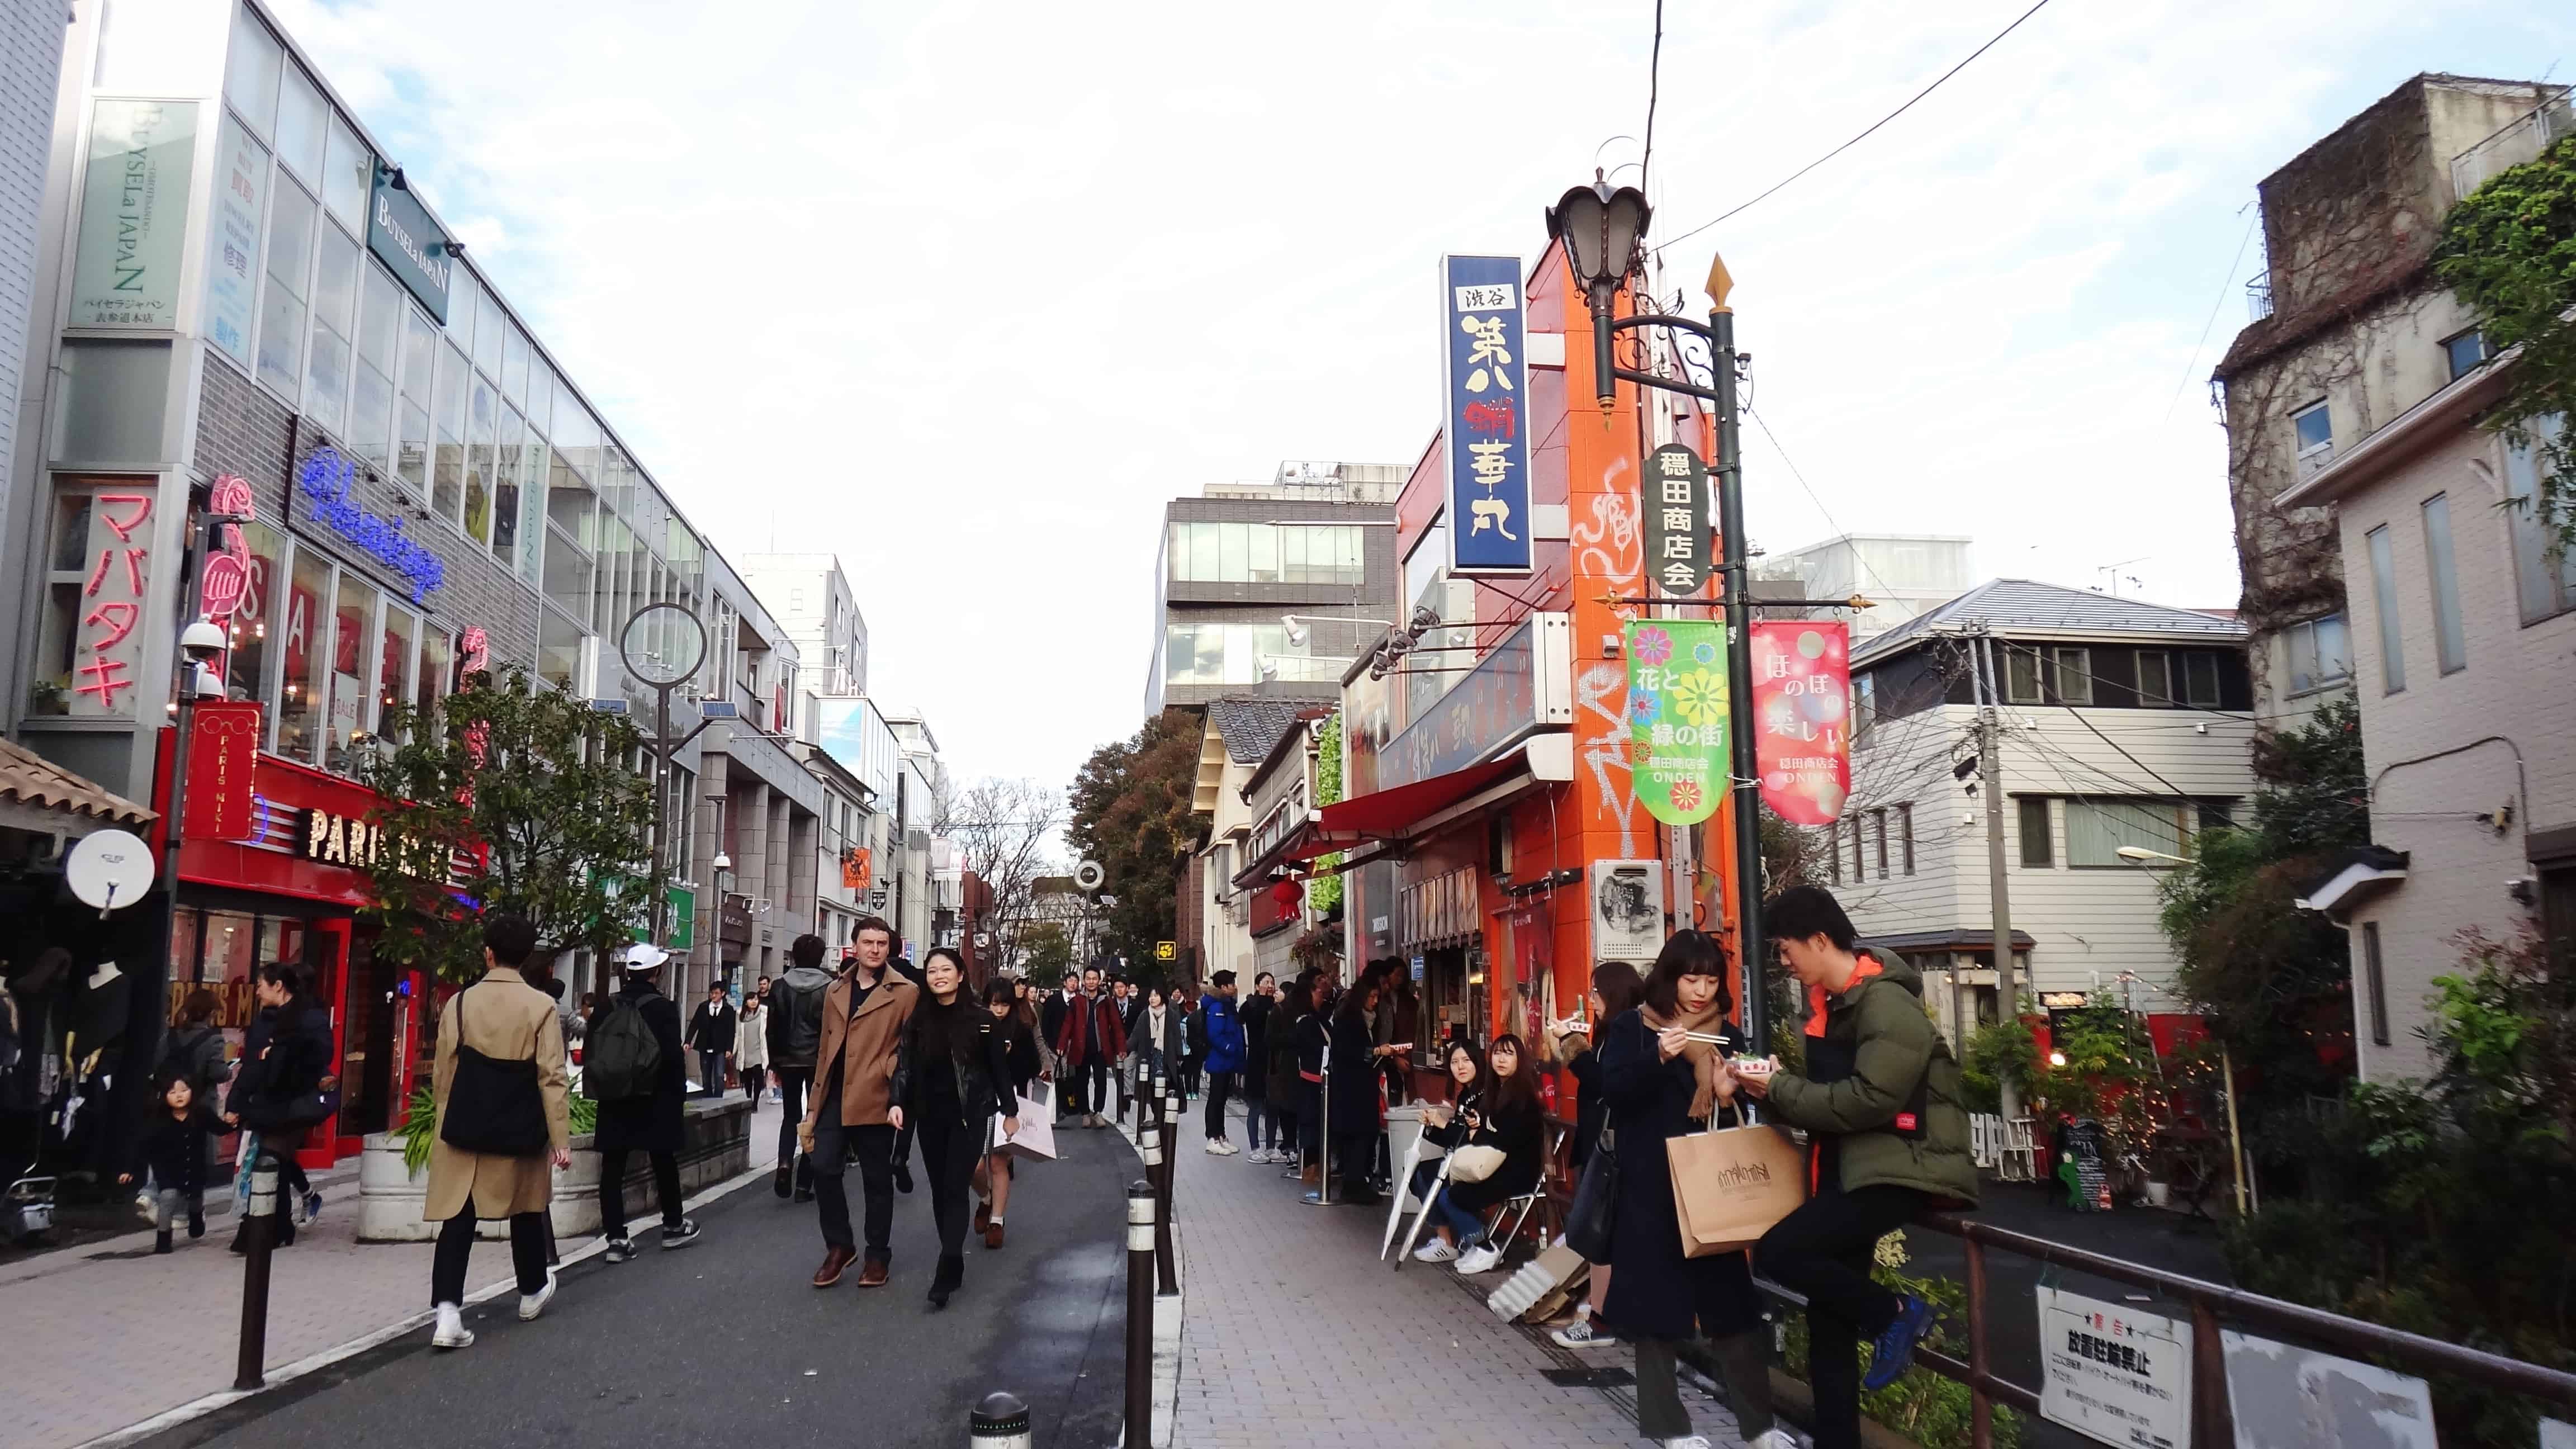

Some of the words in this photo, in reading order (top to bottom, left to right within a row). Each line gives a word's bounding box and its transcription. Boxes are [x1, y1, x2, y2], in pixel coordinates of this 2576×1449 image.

[113, 215, 145, 293] JAPAN
[418, 250, 448, 294] JAPAN
[84, 300, 165, 310] バイセラジャパン
[1466, 290, 1506, 307] 渋谷
[1660, 452, 1695, 586] 穏田商店会
[74, 494, 153, 707] マバタキ
[1637, 668, 1682, 691] 花と
[335, 698, 356, 719] SALE
[1651, 724, 1723, 747] 緑の街
[1767, 707, 1845, 745] 楽しい
[217, 735, 229, 785] PARIS
[1653, 772, 1706, 783] ONDEN
[1784, 773, 1836, 784] ONDEN
[2067, 1328, 2152, 1378] 放置駐輪禁止
